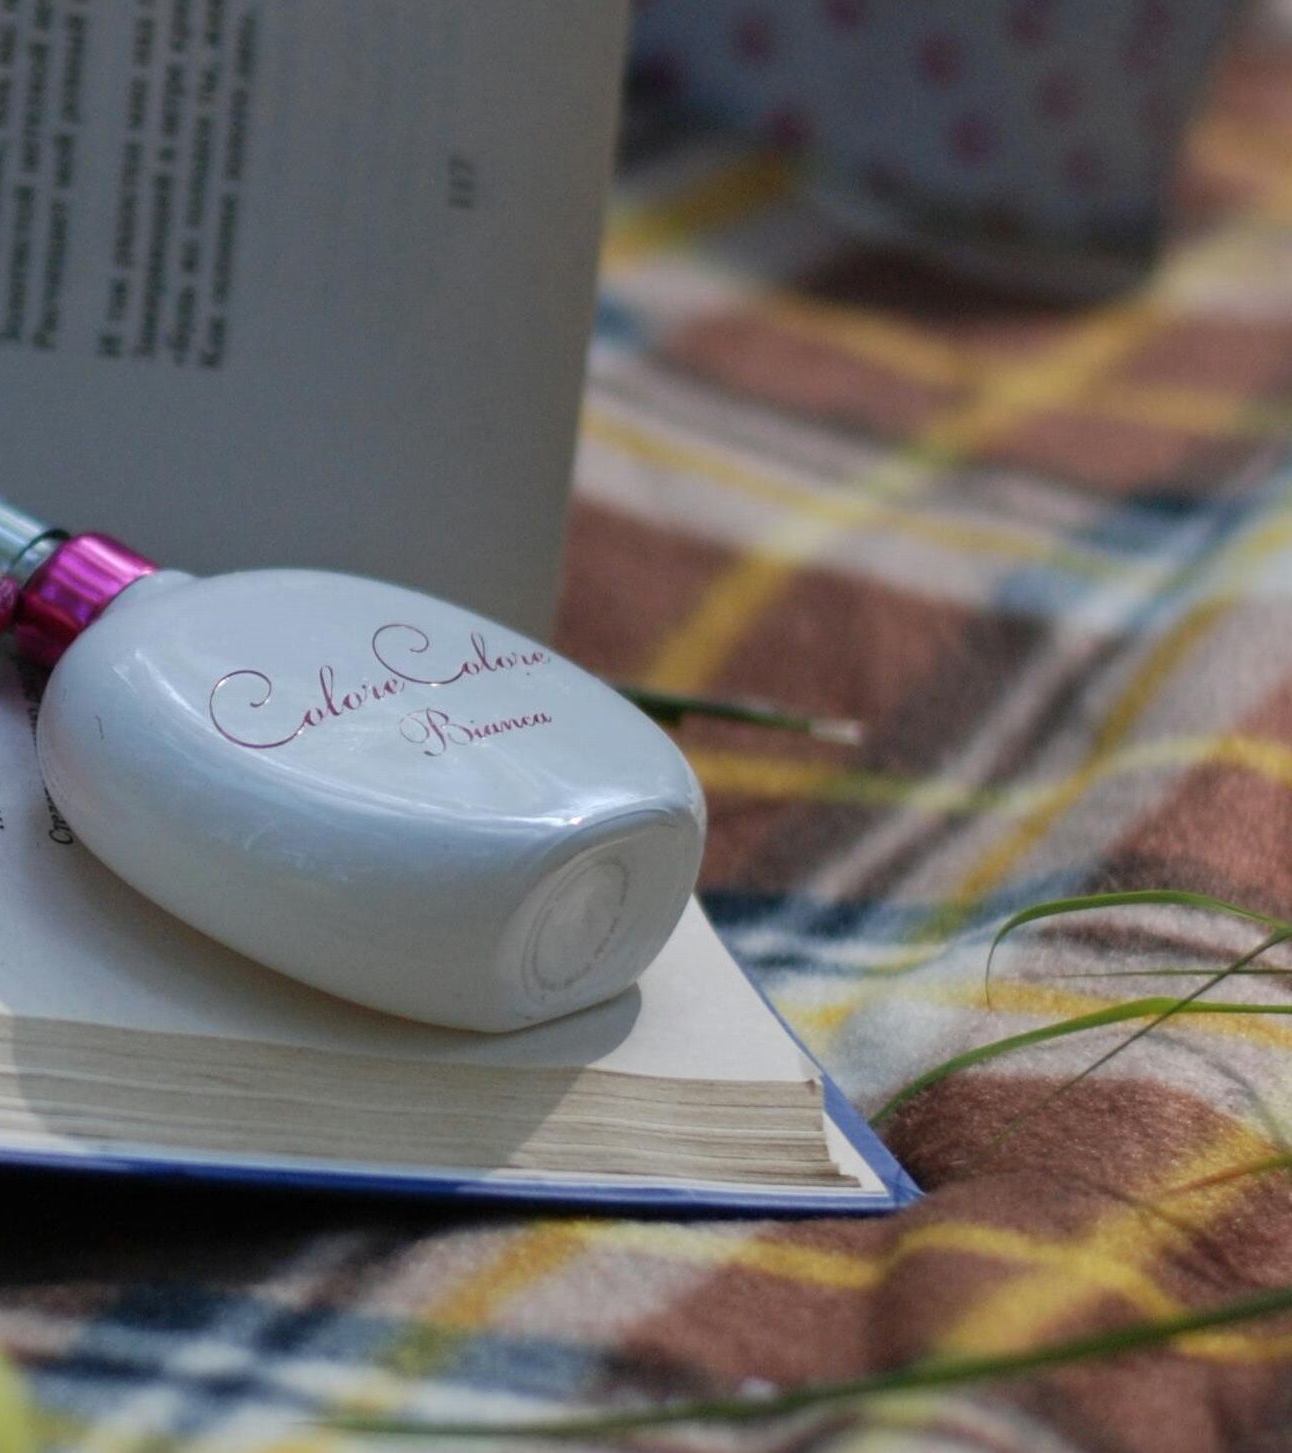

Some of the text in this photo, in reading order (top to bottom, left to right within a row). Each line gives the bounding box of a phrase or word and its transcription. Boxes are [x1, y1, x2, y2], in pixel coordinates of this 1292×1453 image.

[209, 623, 553, 750] Colore Colore
[399, 708, 553, 756] Bianca
